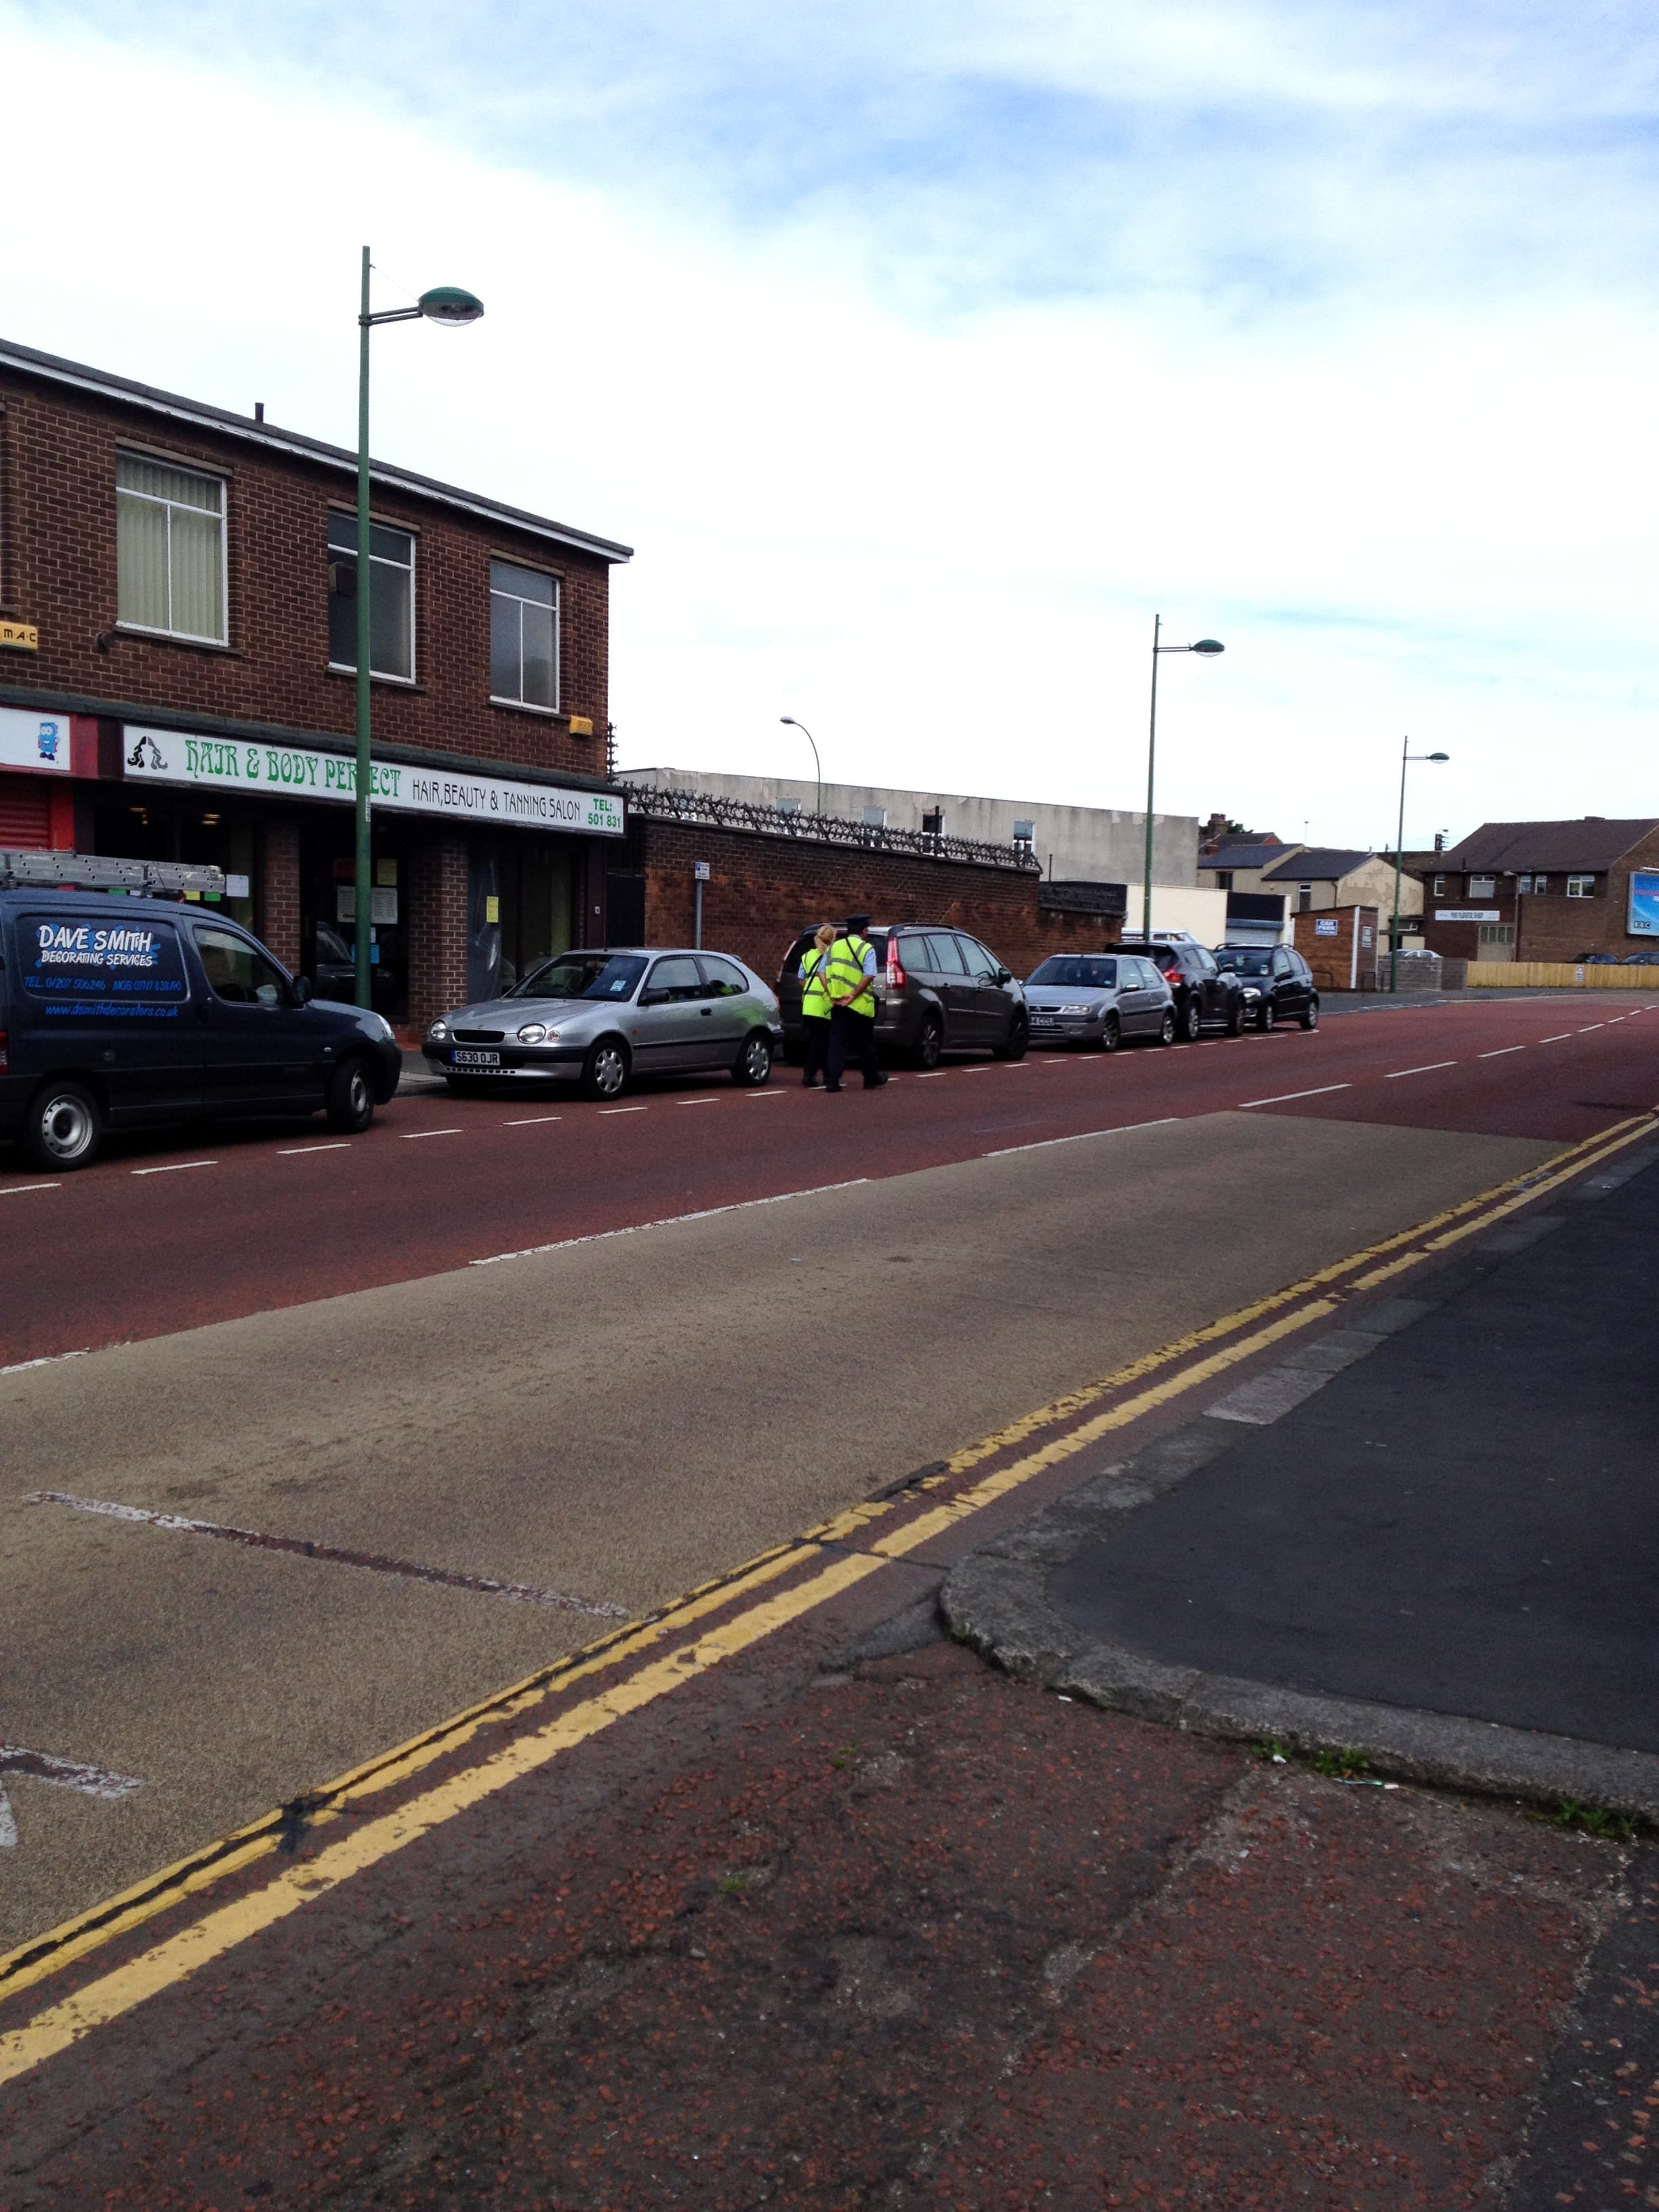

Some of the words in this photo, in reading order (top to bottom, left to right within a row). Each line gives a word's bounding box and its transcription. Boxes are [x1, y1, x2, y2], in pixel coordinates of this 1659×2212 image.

[185, 739, 239, 779] HAIR
[246, 747, 259, 779] &
[266, 750, 319, 786] BODY
[325, 759, 401, 797] PERECT
[490, 790, 499, 811] &
[504, 791, 546, 817] TANNING
[550, 798, 580, 821] SALON
[593, 798, 612, 812] TEL:
[588, 813, 603, 825] 501
[607, 815, 621, 828] 831
[1634, 921, 1651, 929] BBC
[39, 924, 89, 949] DAVE
[94, 929, 152, 952] SMITH
[41, 950, 104, 964] DECORATING
[106, 954, 152, 967] SERVICES
